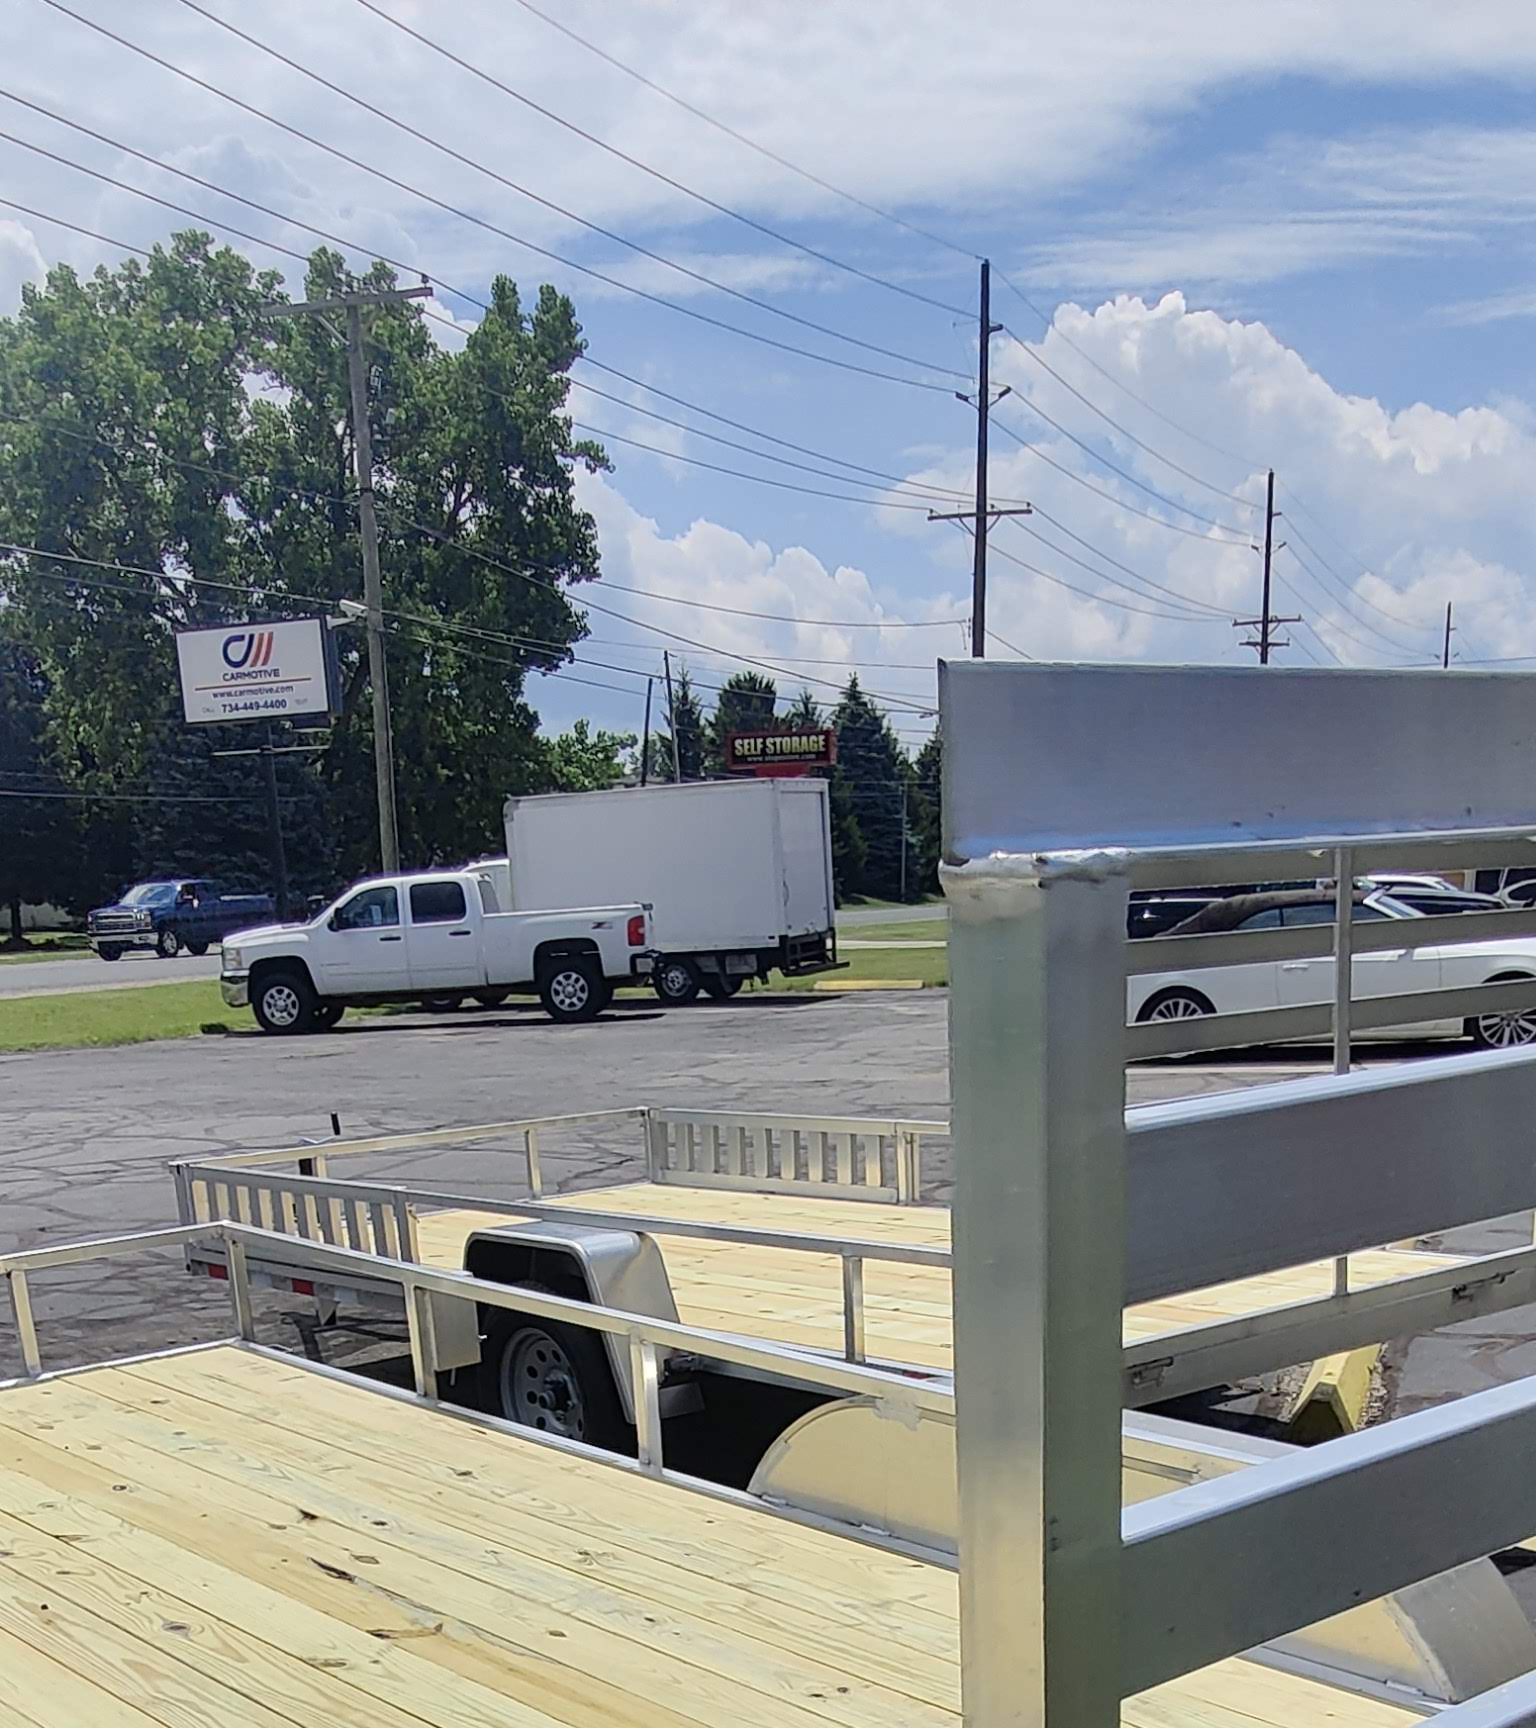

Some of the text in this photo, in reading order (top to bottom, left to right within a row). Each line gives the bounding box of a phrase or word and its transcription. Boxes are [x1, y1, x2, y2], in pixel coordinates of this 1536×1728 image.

[222, 669, 280, 682] CARMOTIVE
[212, 685, 294, 698] www.carmotive.com
[221, 699, 287, 713] 734-449-4400
[734, 735, 826, 756] SELF STORAGE
